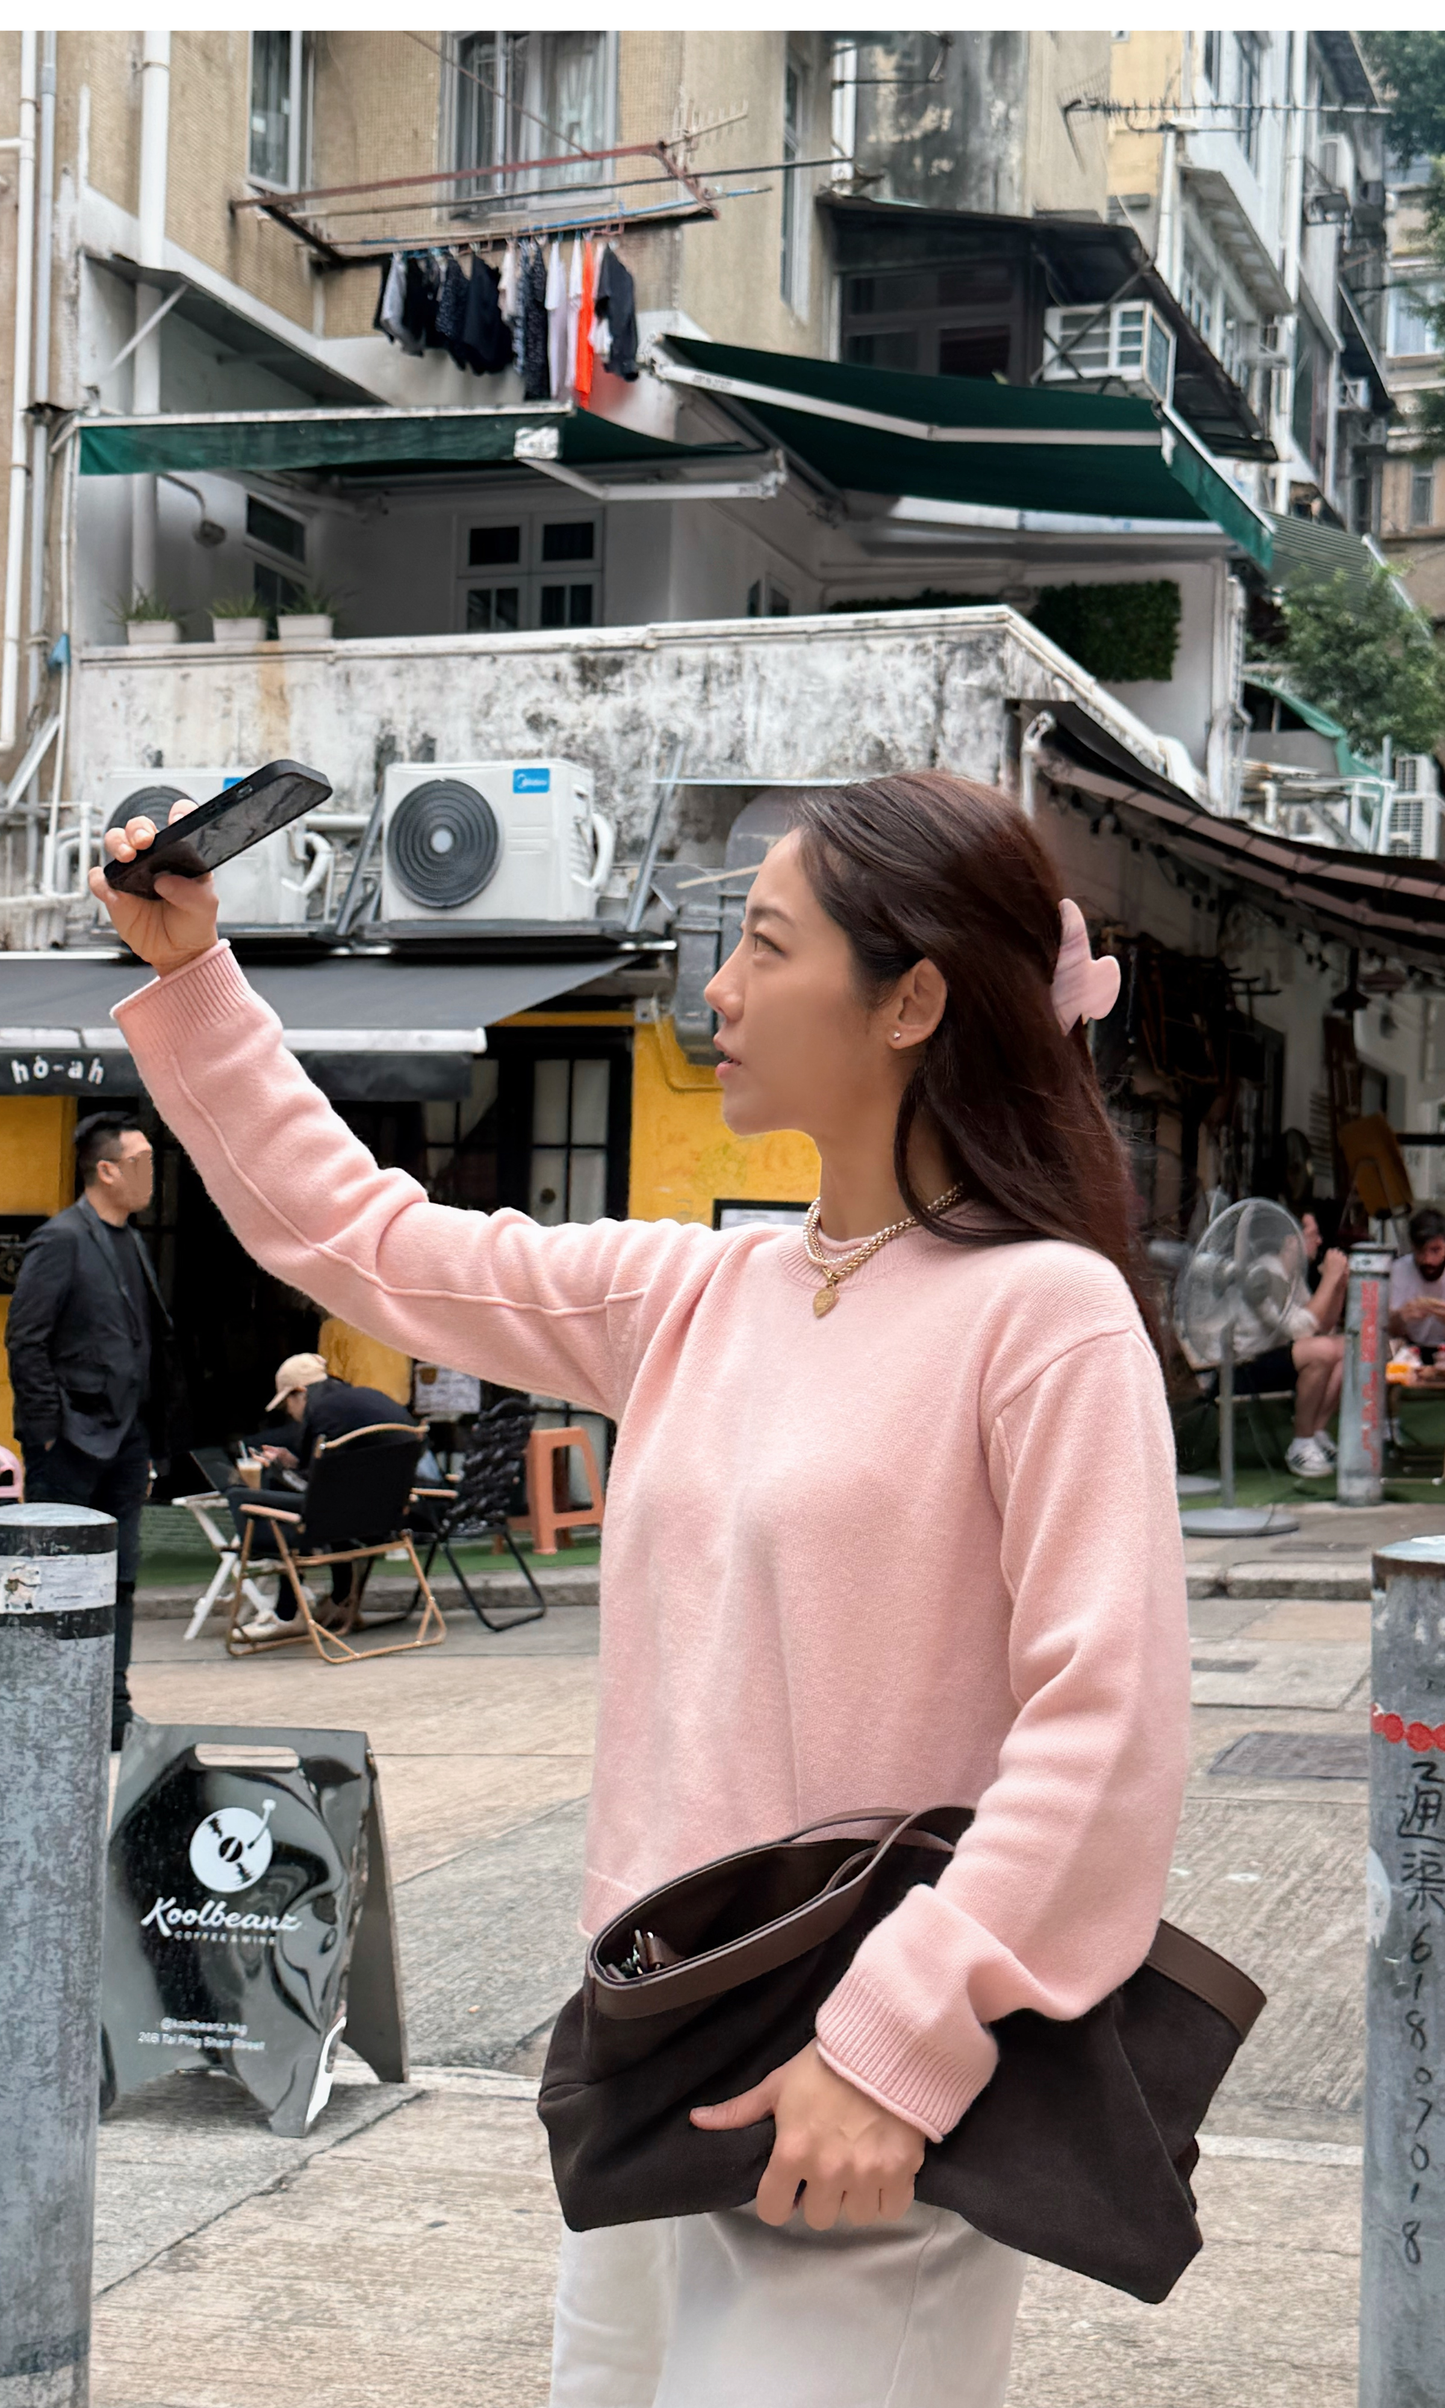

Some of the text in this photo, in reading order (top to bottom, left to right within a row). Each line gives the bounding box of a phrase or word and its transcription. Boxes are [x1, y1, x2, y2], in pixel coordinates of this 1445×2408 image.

[140, 1896, 303, 1938] Koolbeanz
[174, 1930, 228, 1943] COFFEE
[241, 1934, 276, 1946] WINE
[162, 2033, 177, 2045] Tai
[178, 2034, 201, 2049] Ping
[203, 2036, 231, 2048] Shan
[232, 2037, 266, 2051] Street
